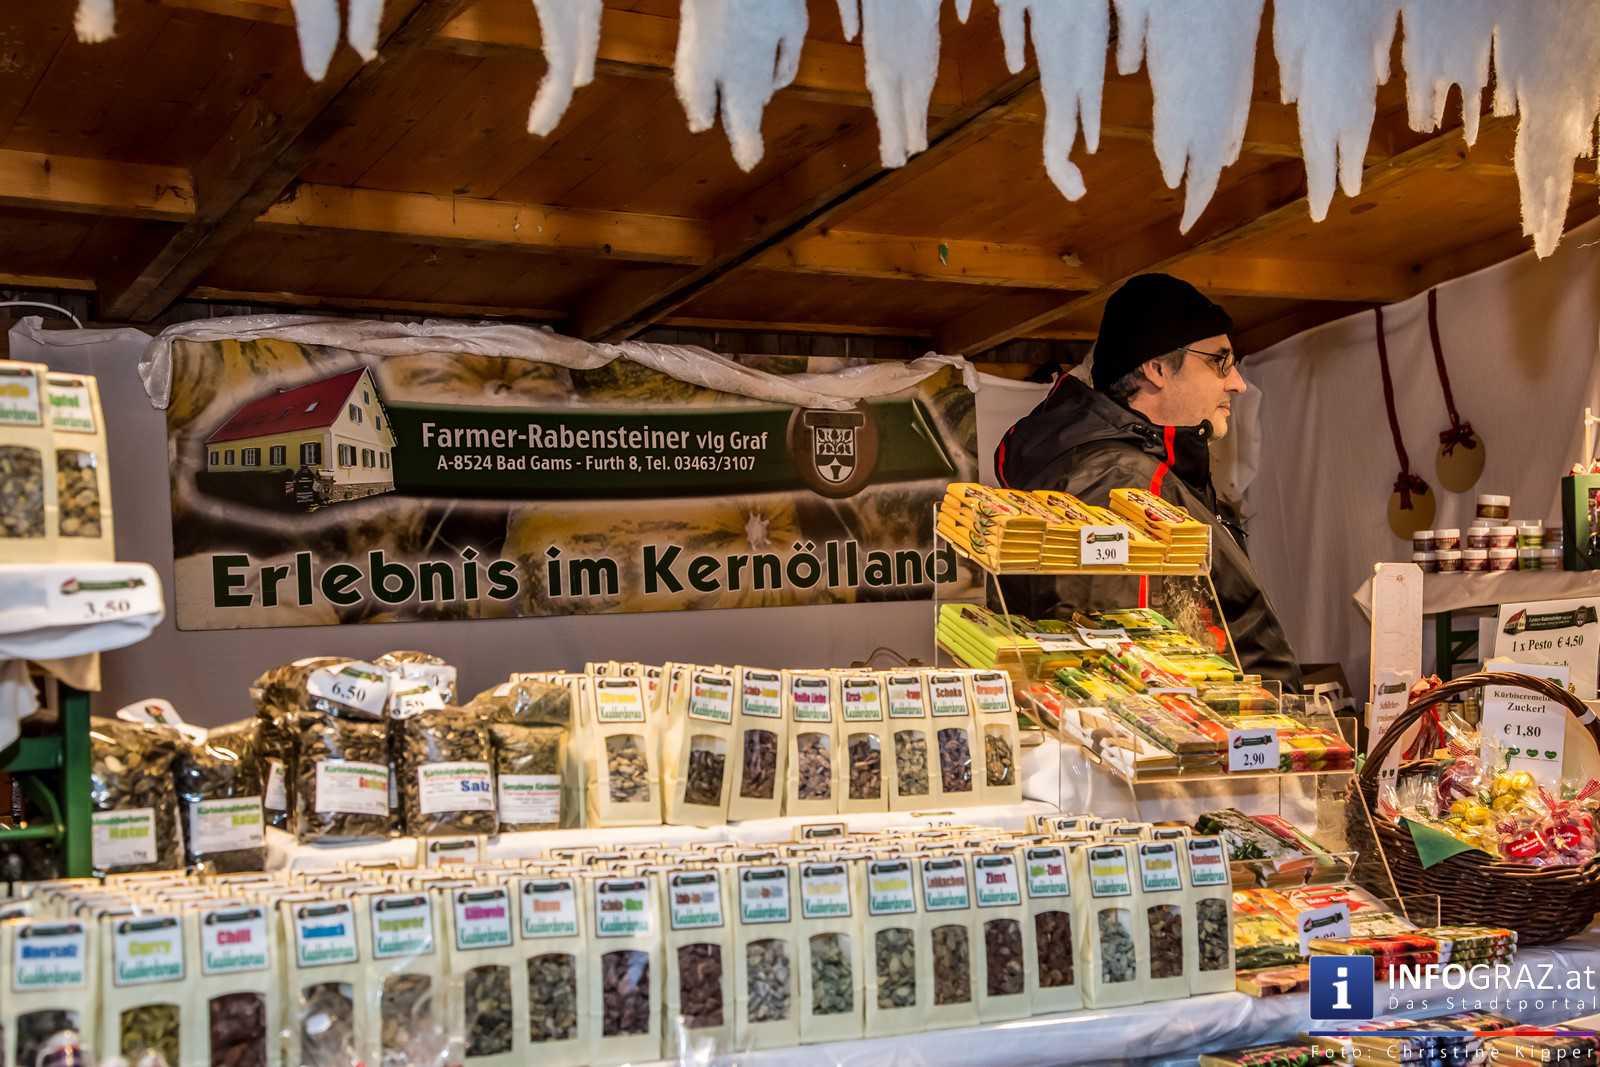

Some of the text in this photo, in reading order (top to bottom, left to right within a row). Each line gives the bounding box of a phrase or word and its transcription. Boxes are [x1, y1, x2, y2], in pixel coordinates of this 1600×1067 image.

[421, 422, 768, 453] Farmer-Rabensteiner vlg Graf
[437, 455, 493, 471] A-8524
[497, 455, 526, 471] Bad
[530, 455, 573, 471] Gams
[586, 455, 625, 471] Furth
[629, 456, 642, 473] 8,
[647, 455, 671, 471] Tel.
[674, 454, 756, 472] 03463/3107
[212, 540, 959, 608] Erlebnis im Kernölland
[1512, 641, 1517, 652] 1
[1519, 643, 1526, 652] x
[1527, 639, 1553, 651] Pesto
[935, 687, 963, 699] Schoko
[1507, 702, 1546, 713] Zuckerl
[1503, 723, 1513, 735] €
[985, 872, 1007, 885] Zimt
